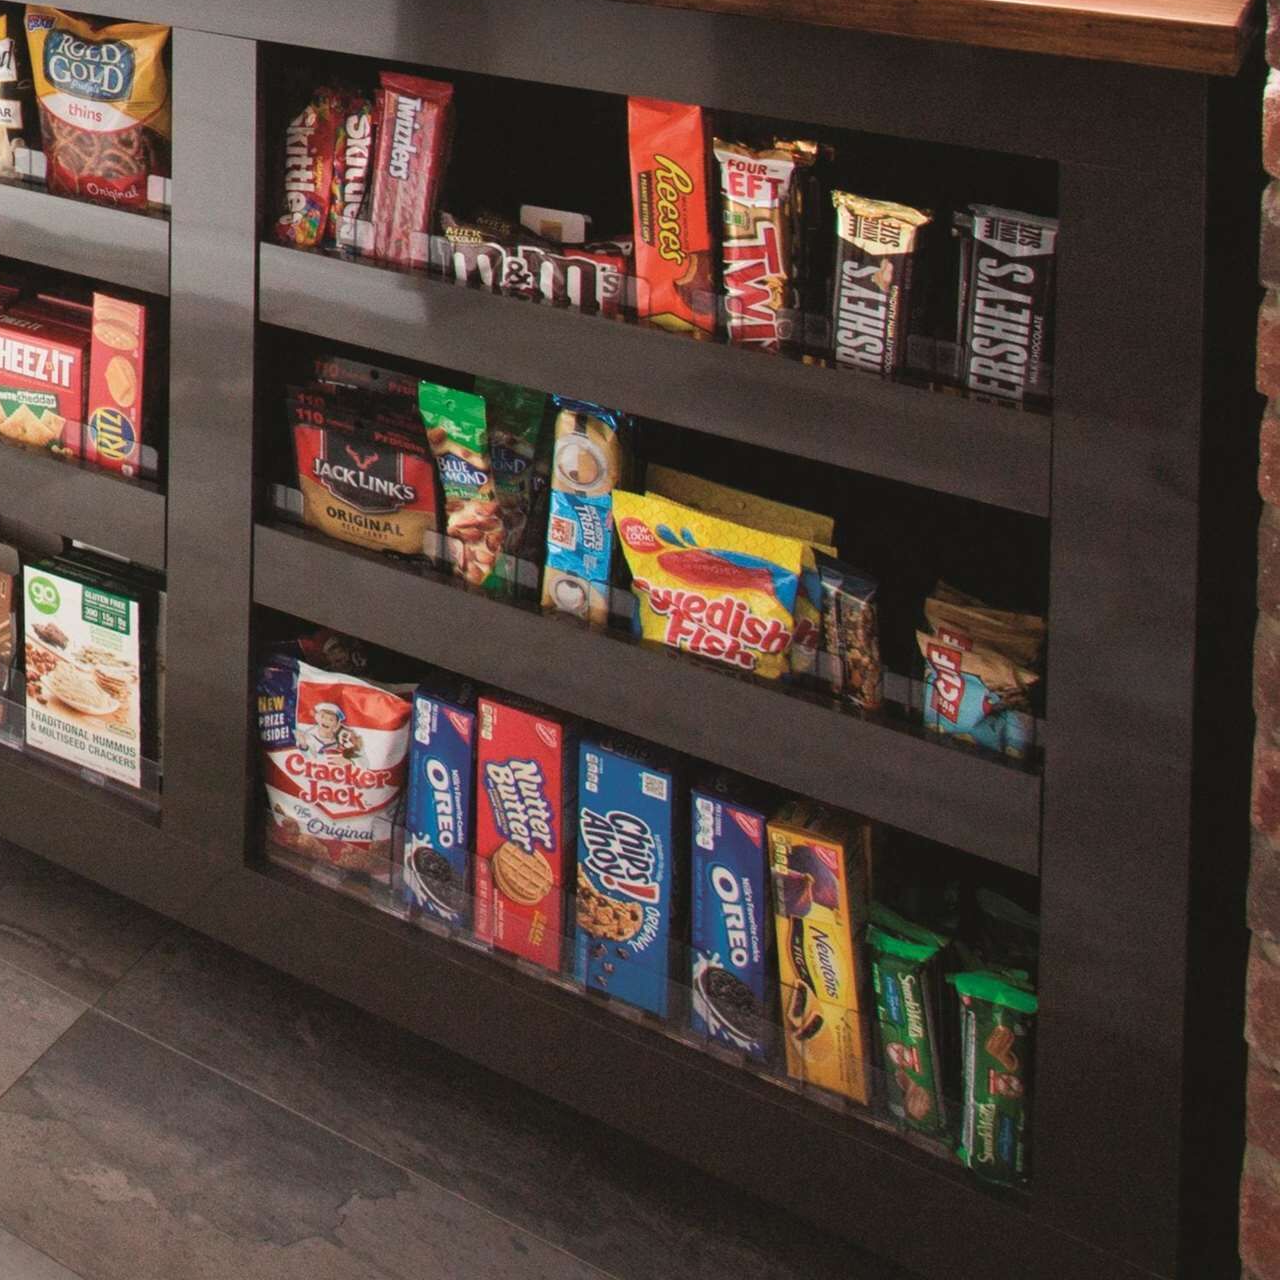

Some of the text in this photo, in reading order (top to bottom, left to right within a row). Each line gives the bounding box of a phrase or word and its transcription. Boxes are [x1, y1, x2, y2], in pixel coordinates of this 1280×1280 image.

[57, 33, 121, 64] ROLD
[47, 55, 124, 95] GOLD
[68, 103, 102, 122] thins
[389, 94, 422, 180] Twizzlers
[279, 107, 317, 226] Skittles
[727, 159, 767, 176] FOUR
[86, 181, 139, 200] Original
[653, 154, 695, 266] Reese's
[880, 219, 901, 248] SIZE
[1018, 220, 1042, 249] SIZE
[836, 260, 888, 373] RSHEY'S
[968, 257, 1035, 401] ERSHEY'S
[1030, 315, 1044, 362] CHOCOLATE
[16, 392, 57, 408] cheddar
[96, 408, 125, 459] RITZ
[313, 458, 360, 488] JACK
[358, 470, 415, 500] LINK'S
[437, 457, 468, 474] BLUE
[326, 505, 405, 537] ORIGINAL
[573, 504, 595, 550] TREATS
[625, 524, 649, 536] NEW
[30, 581, 56, 604] go
[632, 578, 792, 654] Swedish
[667, 609, 755, 668] Fish
[931, 650, 964, 703] CLIF
[258, 694, 284, 710] NEW
[30, 708, 90, 741] TRADITIONAL
[91, 731, 137, 757] HUMMUS
[38, 724, 86, 751] MULTISEED
[87, 744, 137, 771] CRACKERS
[284, 752, 392, 791] Cracker
[293, 803, 312, 819] The
[298, 779, 367, 812] Jack
[425, 756, 454, 849] OREO
[485, 762, 534, 852] Butter
[508, 758, 556, 850] Nutter
[306, 817, 375, 841] Original
[627, 905, 661, 953] ORIGINAL
[710, 864, 750, 969] OREO
[808, 924, 839, 1003] Newtons
